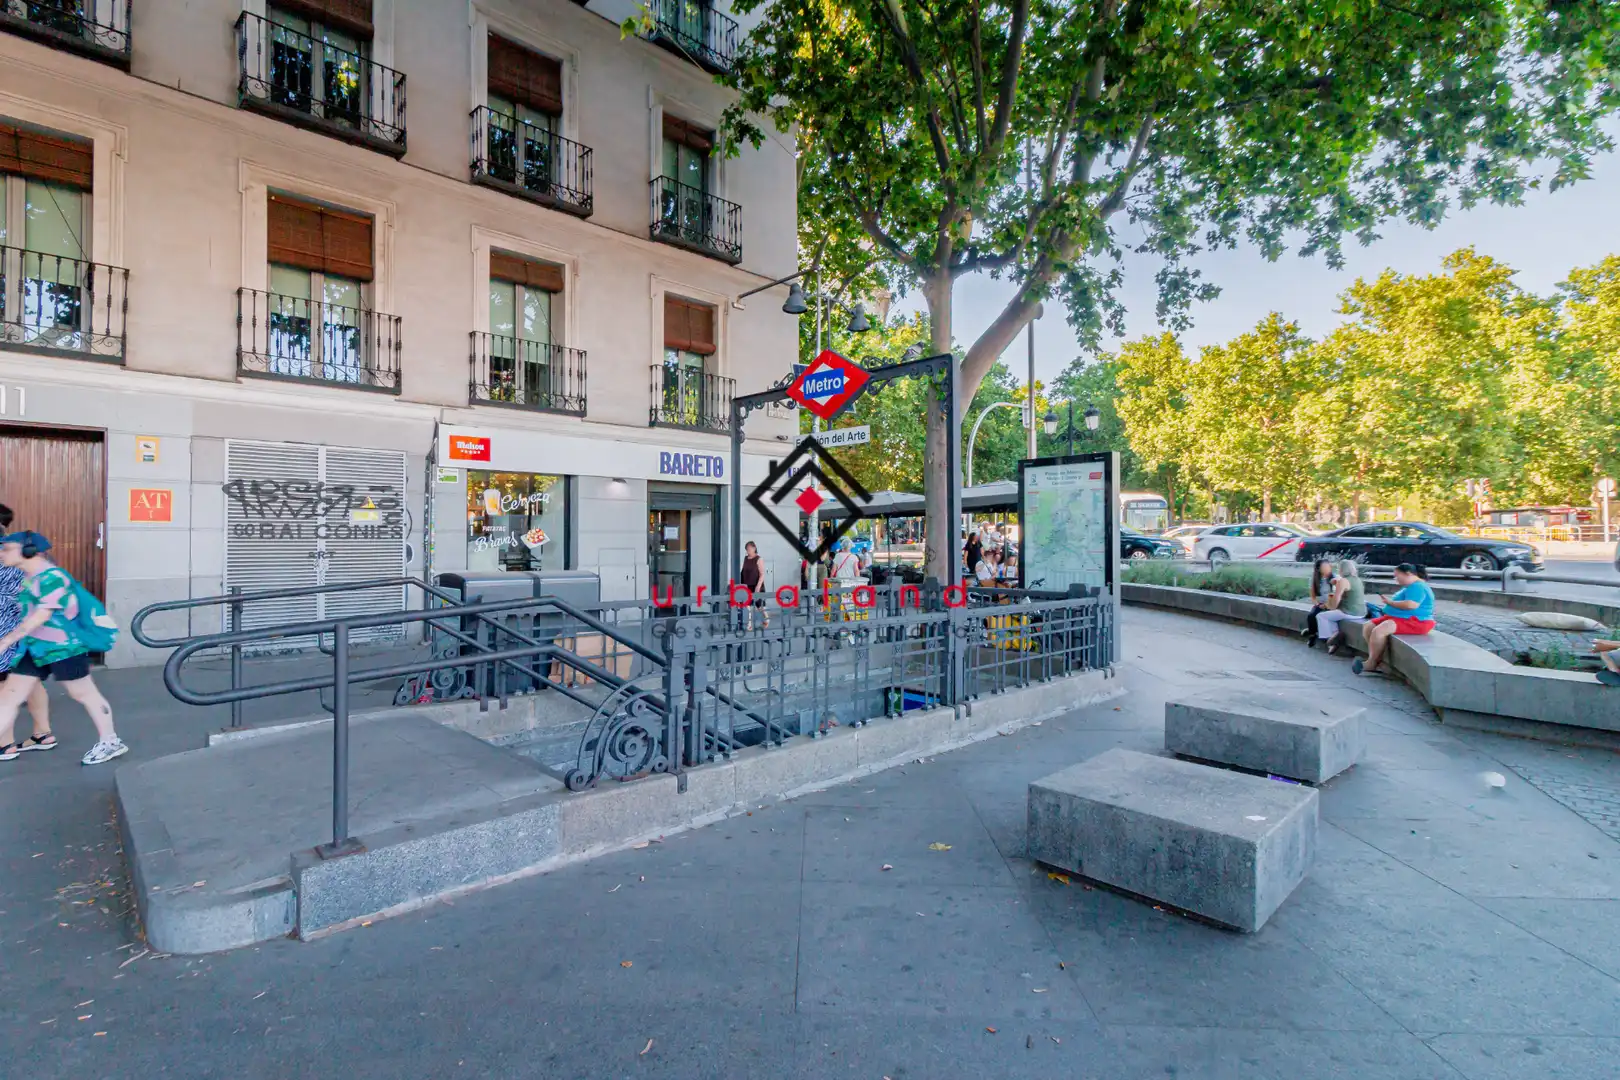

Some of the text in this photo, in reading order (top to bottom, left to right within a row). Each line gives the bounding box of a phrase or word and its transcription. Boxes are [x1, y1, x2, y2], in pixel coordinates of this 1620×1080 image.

[805, 377, 841, 395] Metro
[456, 441, 484, 450] Mahou
[832, 432, 845, 443] del
[847, 431, 866, 441] Arte
[660, 451, 724, 478] BARETO
[133, 491, 168, 509] AT
[501, 492, 550, 512] Cerveza
[474, 531, 518, 552] Bravas
